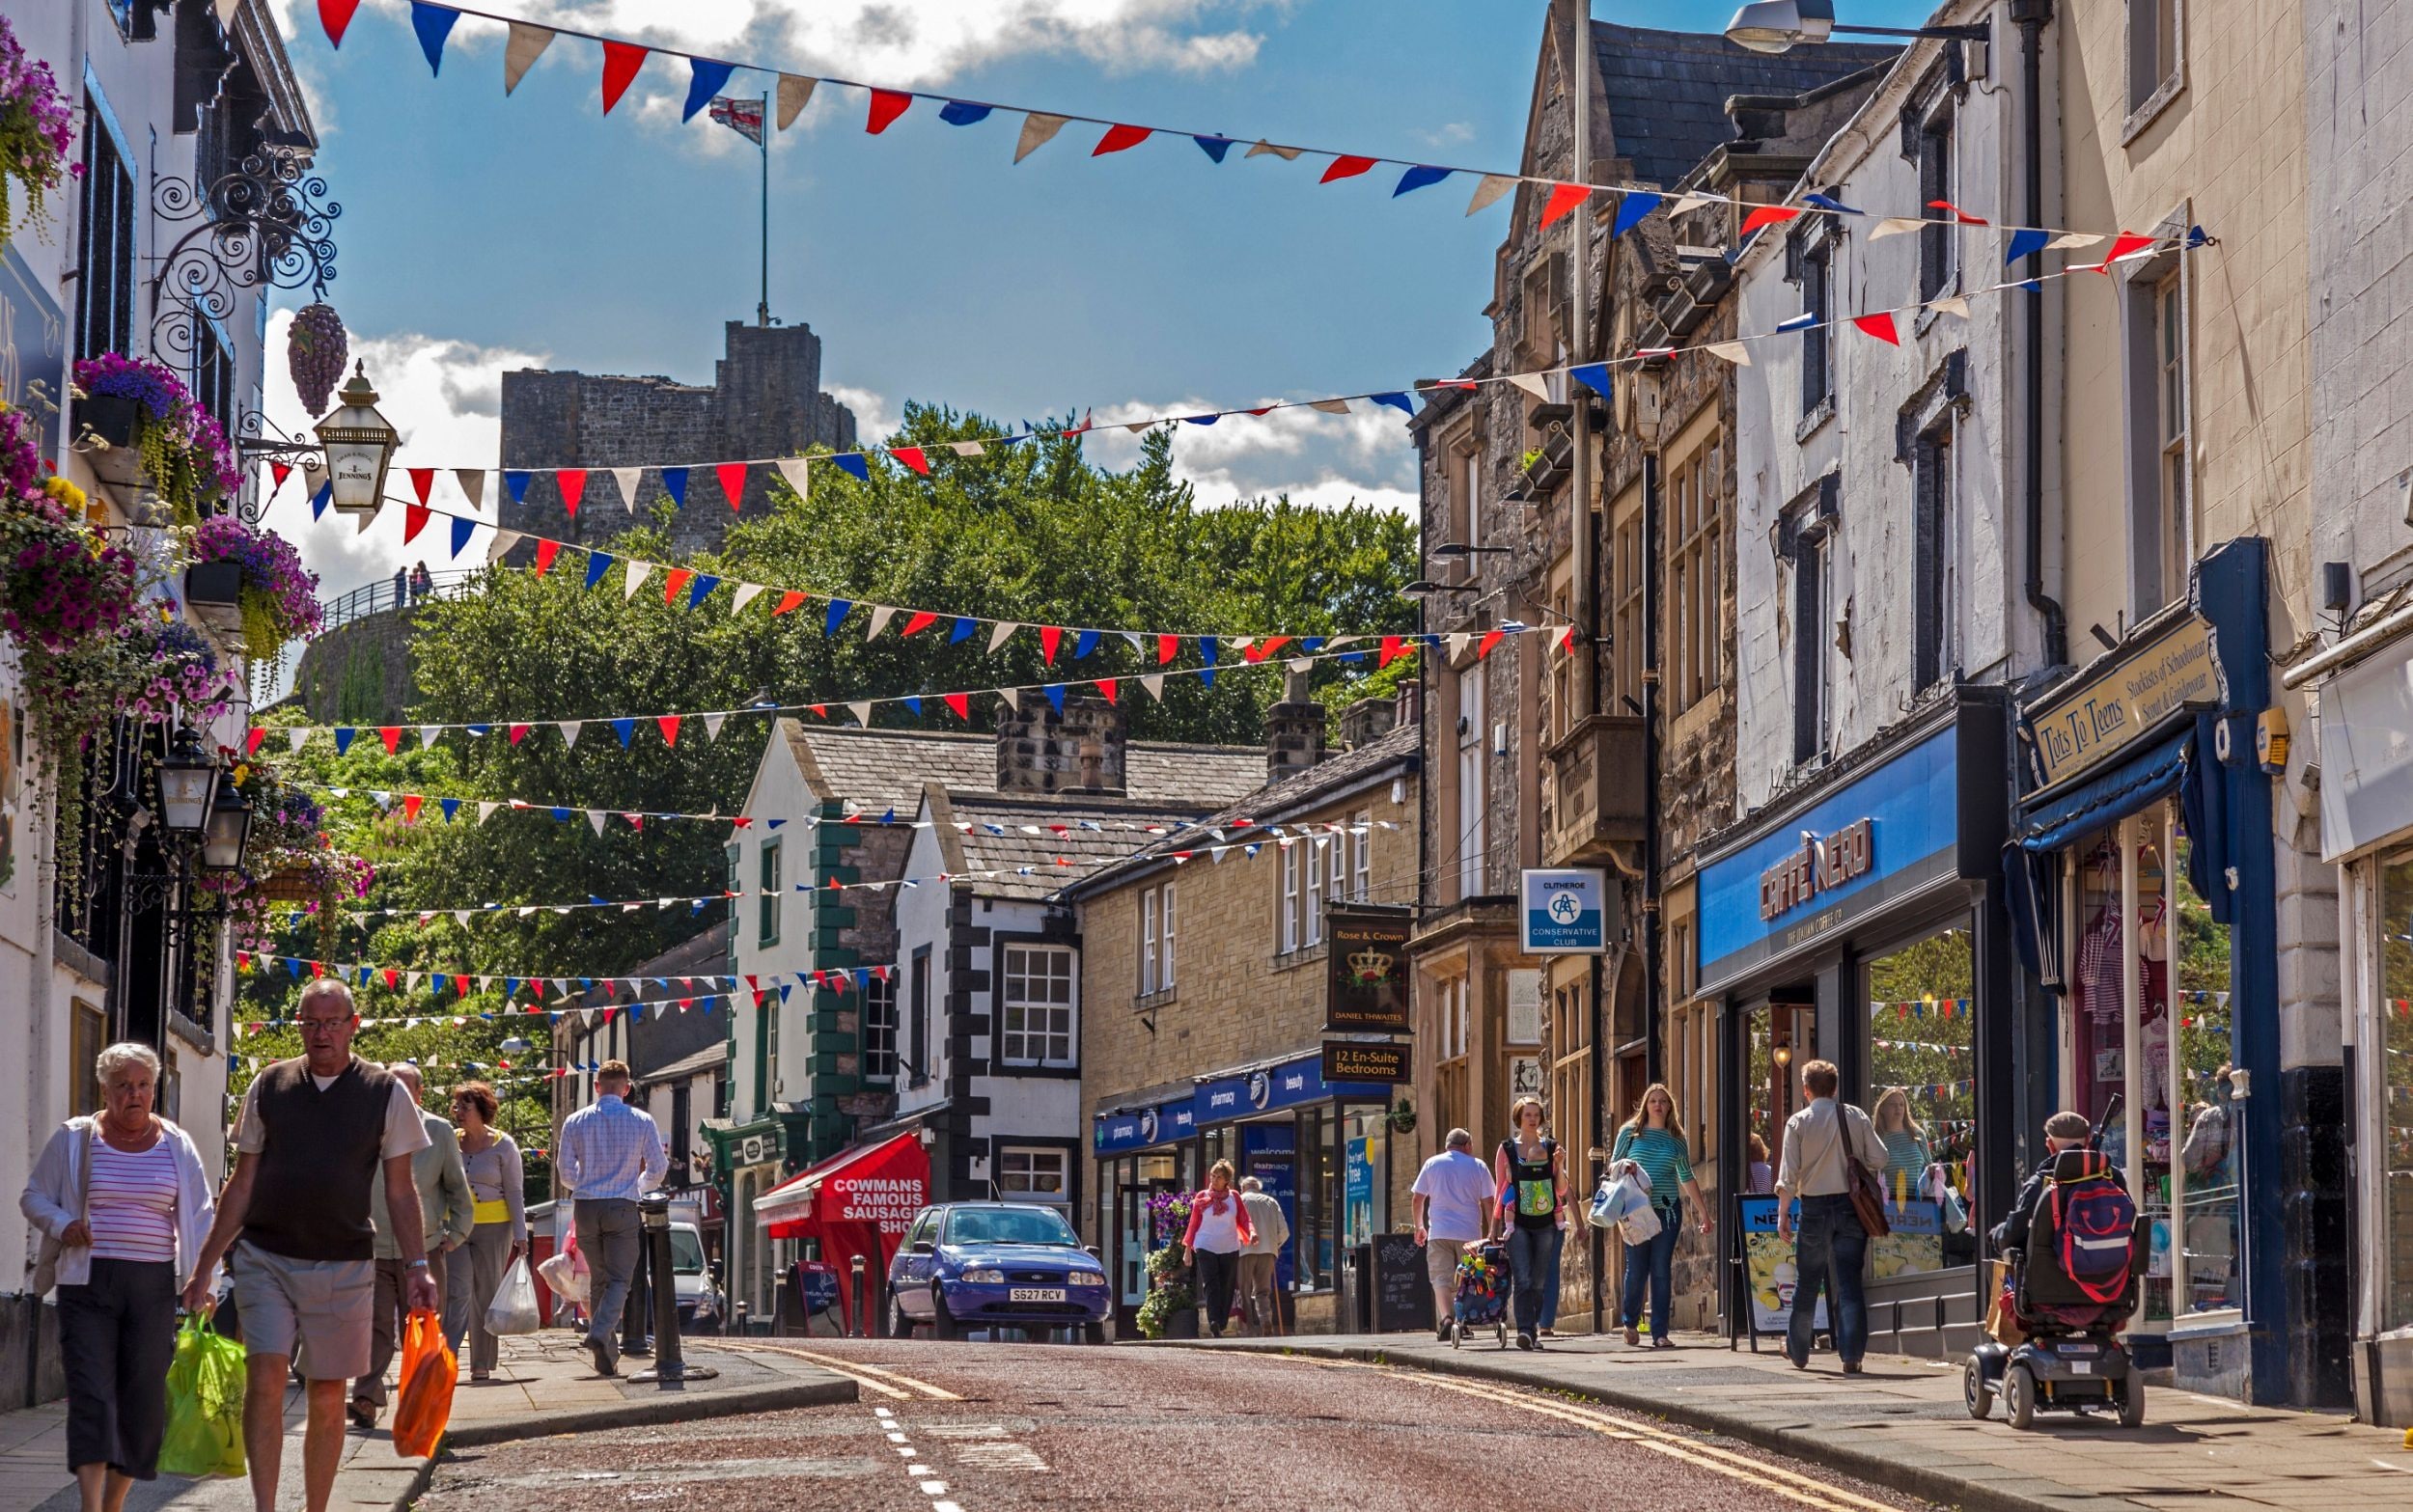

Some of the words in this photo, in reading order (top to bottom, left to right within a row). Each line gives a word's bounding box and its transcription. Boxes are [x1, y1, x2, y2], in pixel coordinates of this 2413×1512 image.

[338, 472, 372, 481] JENNINGS
[2126, 667, 2159, 700] Stockists
[2158, 659, 2168, 683] of
[2166, 640, 2205, 675] Schoolwear
[2142, 698, 2163, 723] Scout
[2162, 692, 2170, 711] &
[2170, 673, 2207, 706] Guidewear
[2040, 725, 2071, 770] Tots
[2066, 710, 2087, 754] To
[2085, 698, 2123, 744] Teens
[1815, 817, 1872, 893] NERO
[1816, 912, 1834, 932] COFFEE
[1337, 930, 1360, 940] Rose
[1362, 931, 1371, 940] &
[1373, 932, 1404, 941] Crown
[1365, 1012, 1402, 1021] THWAITES
[1336, 1050, 1348, 1061] 12
[1352, 1051, 1399, 1064] En-Suite
[1336, 1062, 1397, 1076] Bedrooms
[1286, 1073, 1303, 1090] beauty
[1210, 1091, 1235, 1109] pharmacy
[1178, 1110, 1192, 1125] beauty
[1113, 1125, 1133, 1141] pharmacy
[1348, 1165, 1362, 1183] free
[834, 1179, 923, 1193] COWMANS
[853, 1193, 923, 1205] FAMOUS
[879, 1221, 913, 1233] SHO
[1013, 1289, 1040, 1300] S627
[1041, 1289, 1062, 1300] RCV
